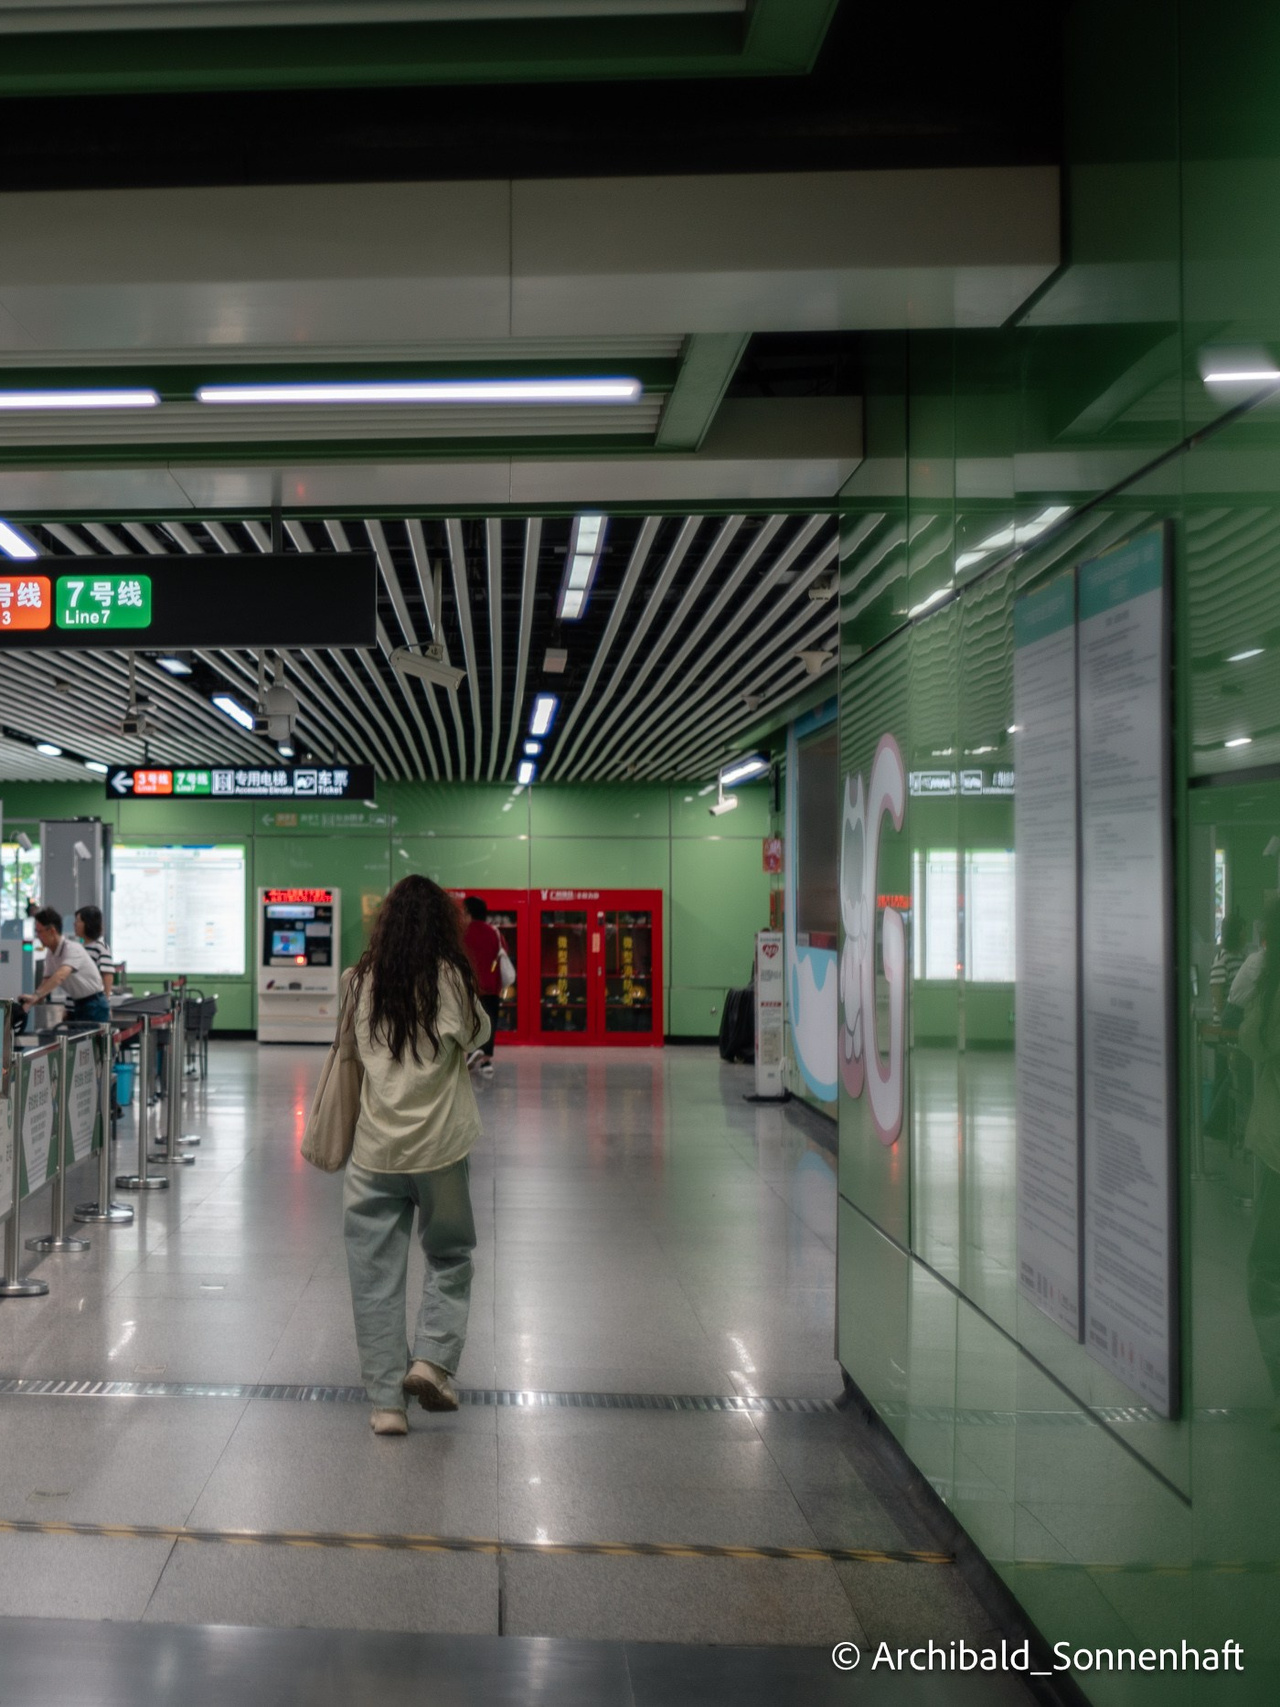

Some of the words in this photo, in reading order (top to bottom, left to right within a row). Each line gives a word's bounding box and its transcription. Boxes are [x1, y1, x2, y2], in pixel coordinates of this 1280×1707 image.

[67, 581, 143, 608] 7号线
[138, 773, 169, 785] 3号线
[177, 772, 208, 785] 7号线
[236, 770, 287, 787] 专用电梯
[318, 770, 348, 787] 车票
[318, 786, 343, 795] Ticket
